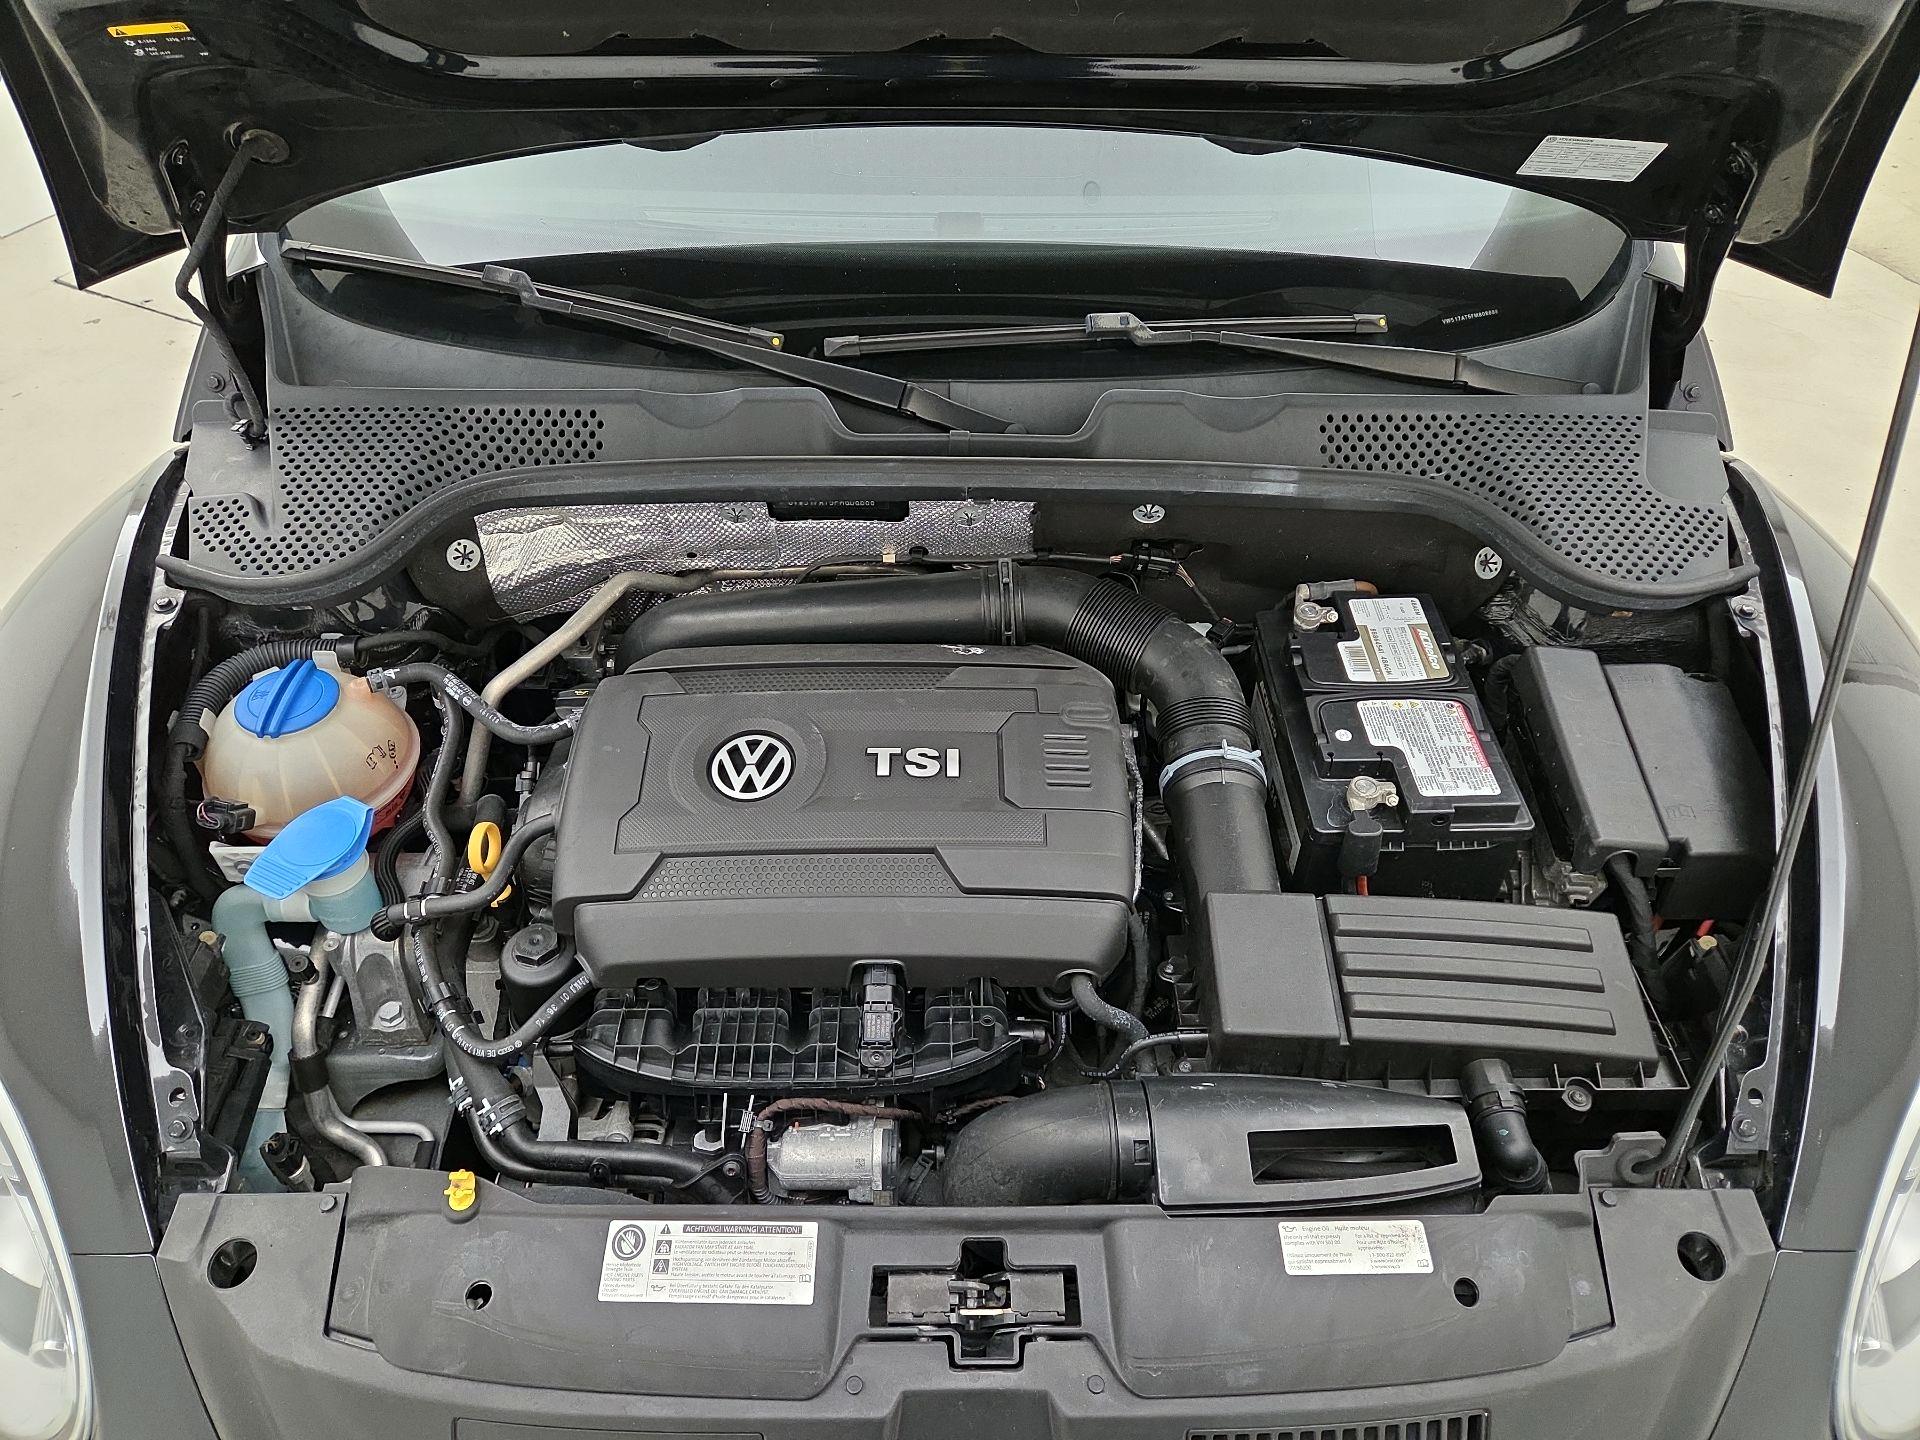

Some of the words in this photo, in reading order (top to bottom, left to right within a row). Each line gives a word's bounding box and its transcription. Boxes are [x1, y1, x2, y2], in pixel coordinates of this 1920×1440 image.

[1417, 628, 1440, 670] ACDelco
[866, 746, 960, 778] TSI
[685, 1225, 722, 1233] ACHTUNG!
[723, 1225, 759, 1234] WARNING!
[760, 1226, 801, 1234] ATTENTION!
[1301, 1225, 1321, 1233] Engine
